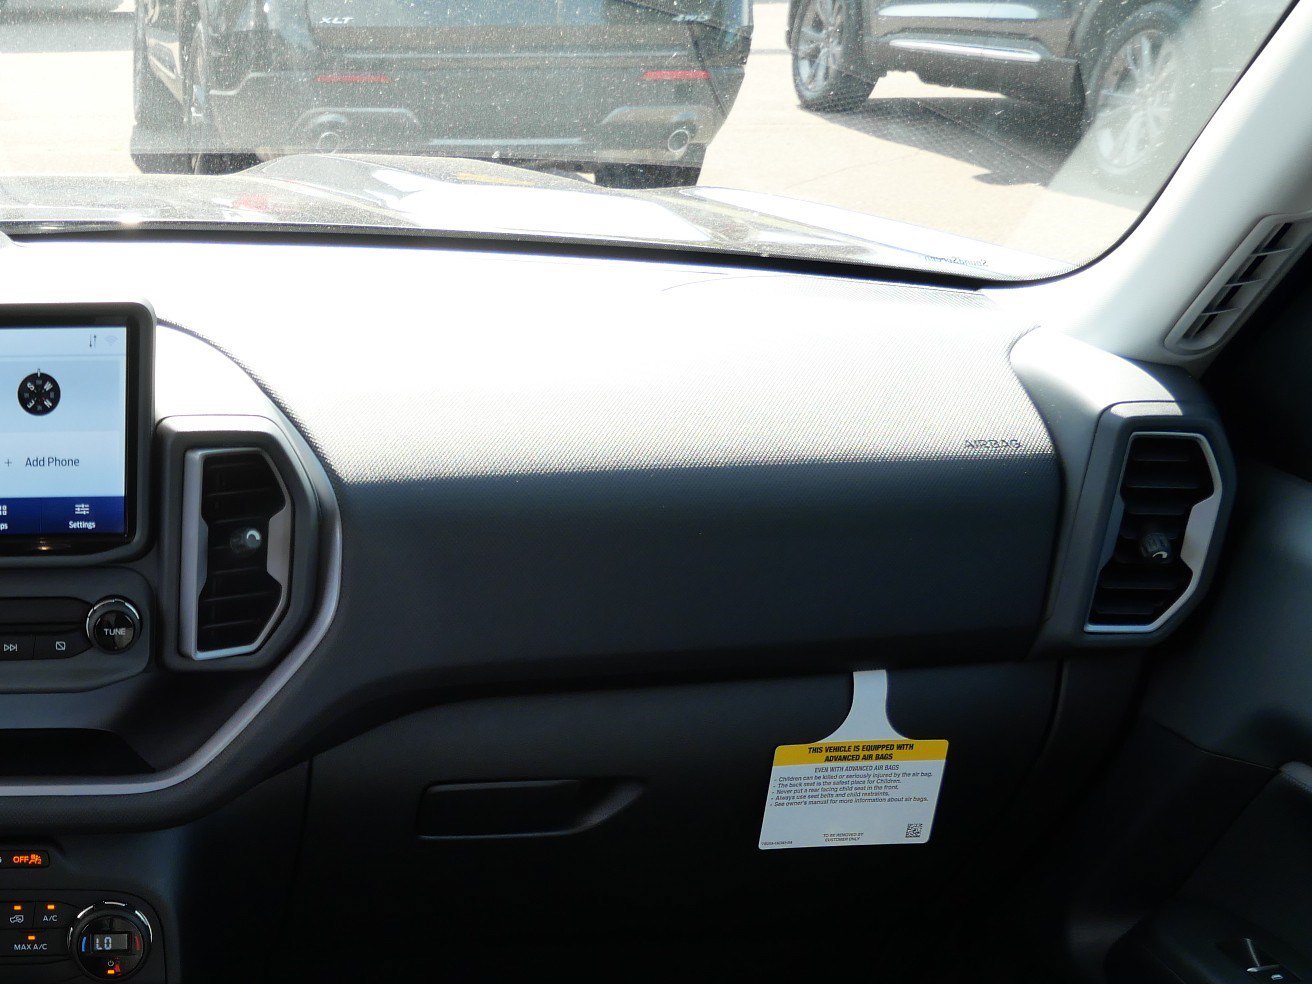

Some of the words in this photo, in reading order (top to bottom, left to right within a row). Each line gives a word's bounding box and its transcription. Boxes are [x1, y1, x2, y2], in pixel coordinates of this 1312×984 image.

[319, 16, 355, 24] XLT
[25, 457, 45, 467] Add
[47, 456, 80, 467] Phone
[68, 520, 96, 530] Settings
[103, 627, 126, 636] TUNE
[808, 746, 823, 754] THIS
[825, 745, 851, 753] VEHICLE
[853, 744, 860, 752] IS
[862, 743, 895, 752] EQUIPPED
[896, 743, 914, 751] WITH
[824, 754, 860, 762] ADVANCED
[862, 753, 873, 761] AIR
[13, 855, 29, 864] OFF
[42, 914, 58, 922] A/C
[13, 943, 32, 951] MAX
[33, 943, 48, 951] A/C
